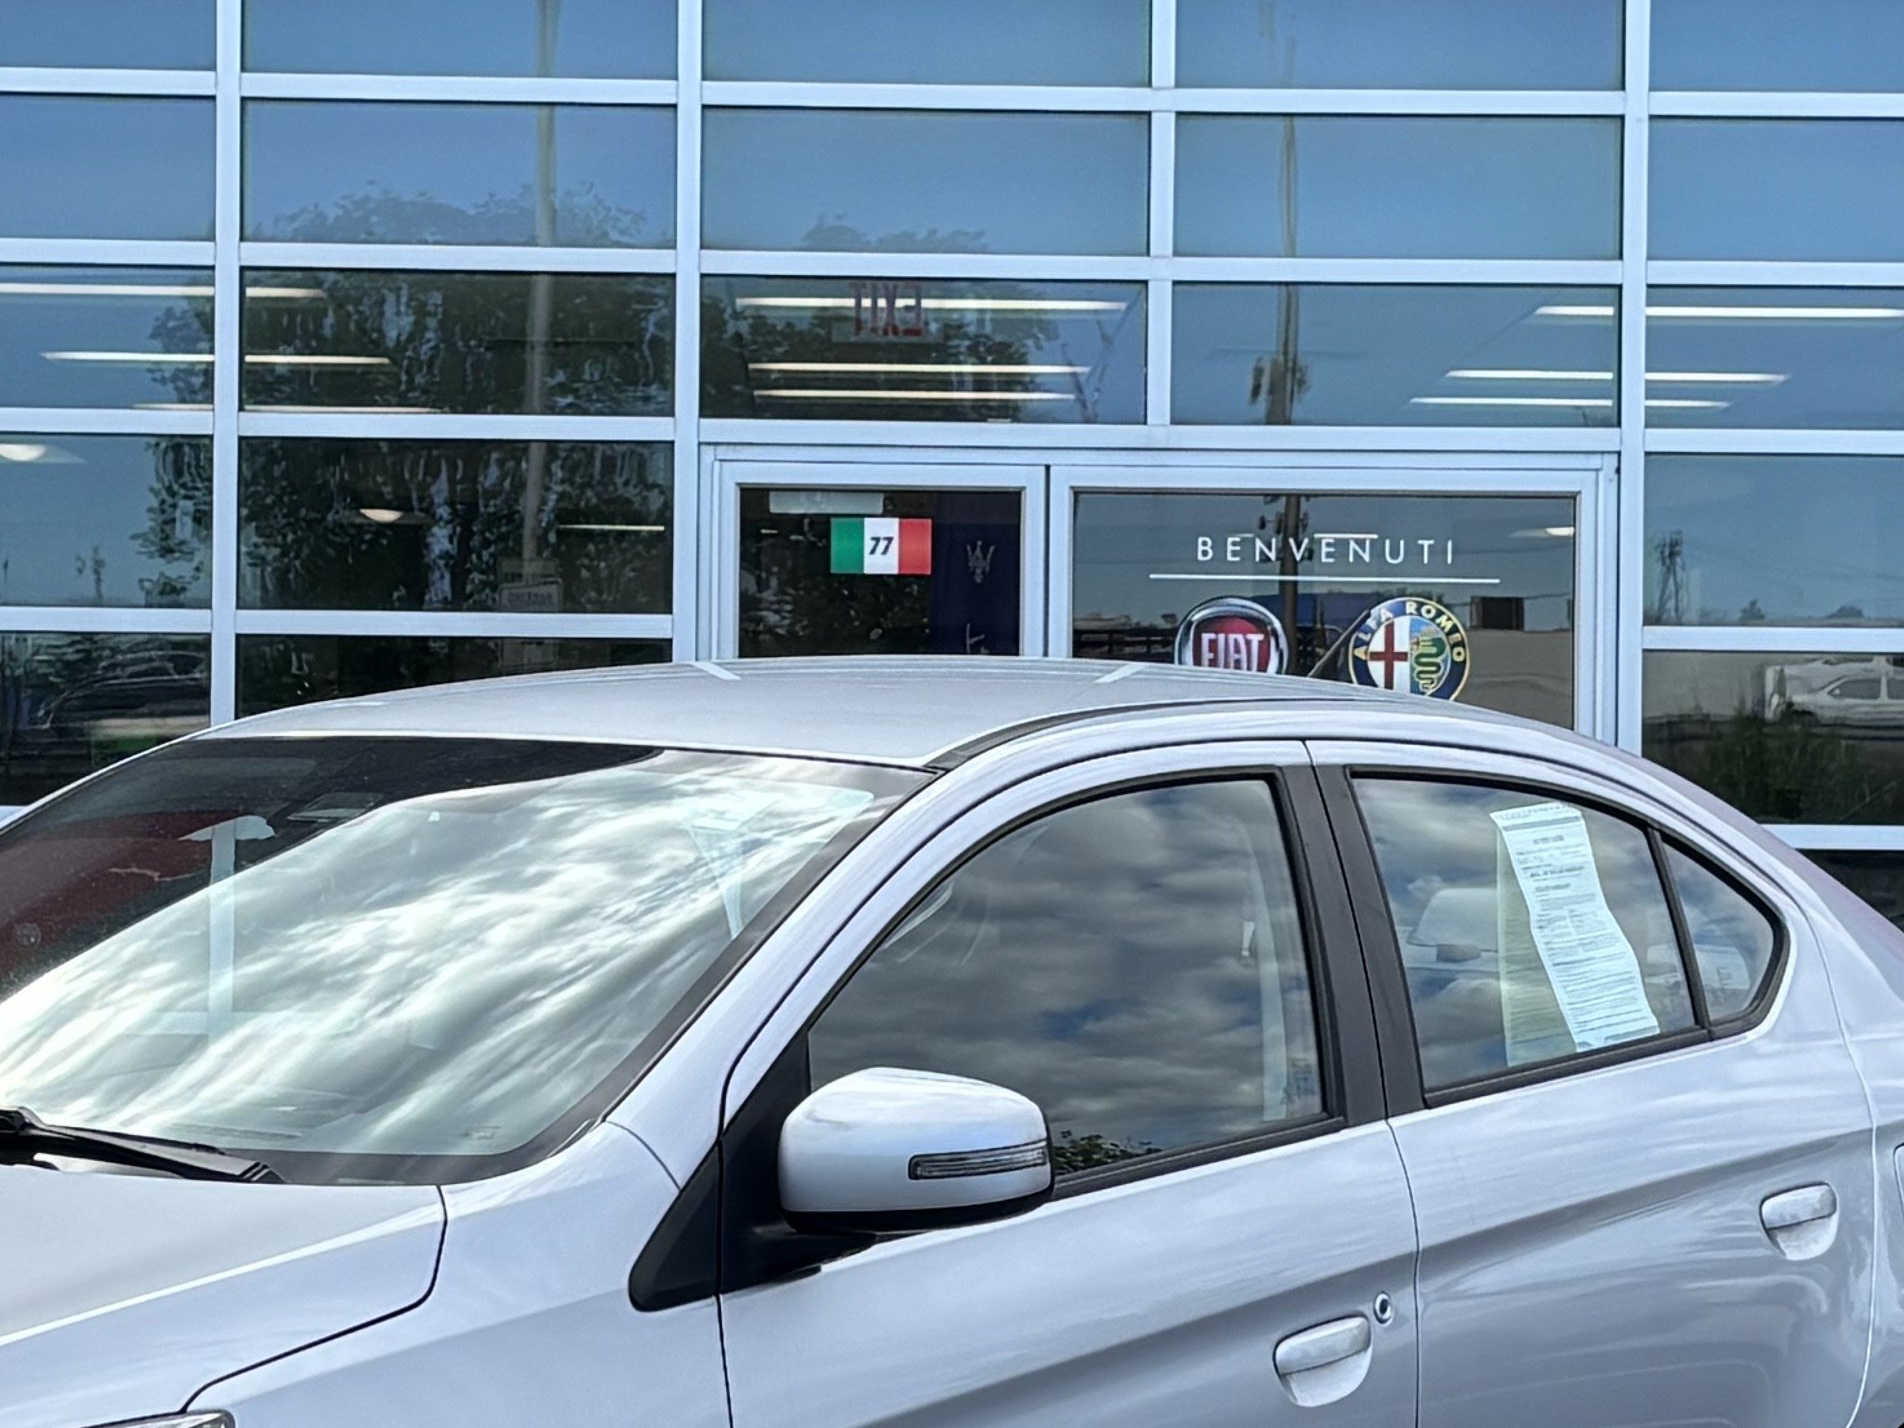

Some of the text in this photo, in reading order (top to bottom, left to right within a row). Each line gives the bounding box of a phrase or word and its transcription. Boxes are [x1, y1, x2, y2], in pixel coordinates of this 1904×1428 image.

[868, 536, 894, 556] 77
[1197, 536, 1453, 565] BENVENUTI
[1353, 601, 1466, 663] ALFA ROMEO
[1201, 633, 1265, 672] FIAT
